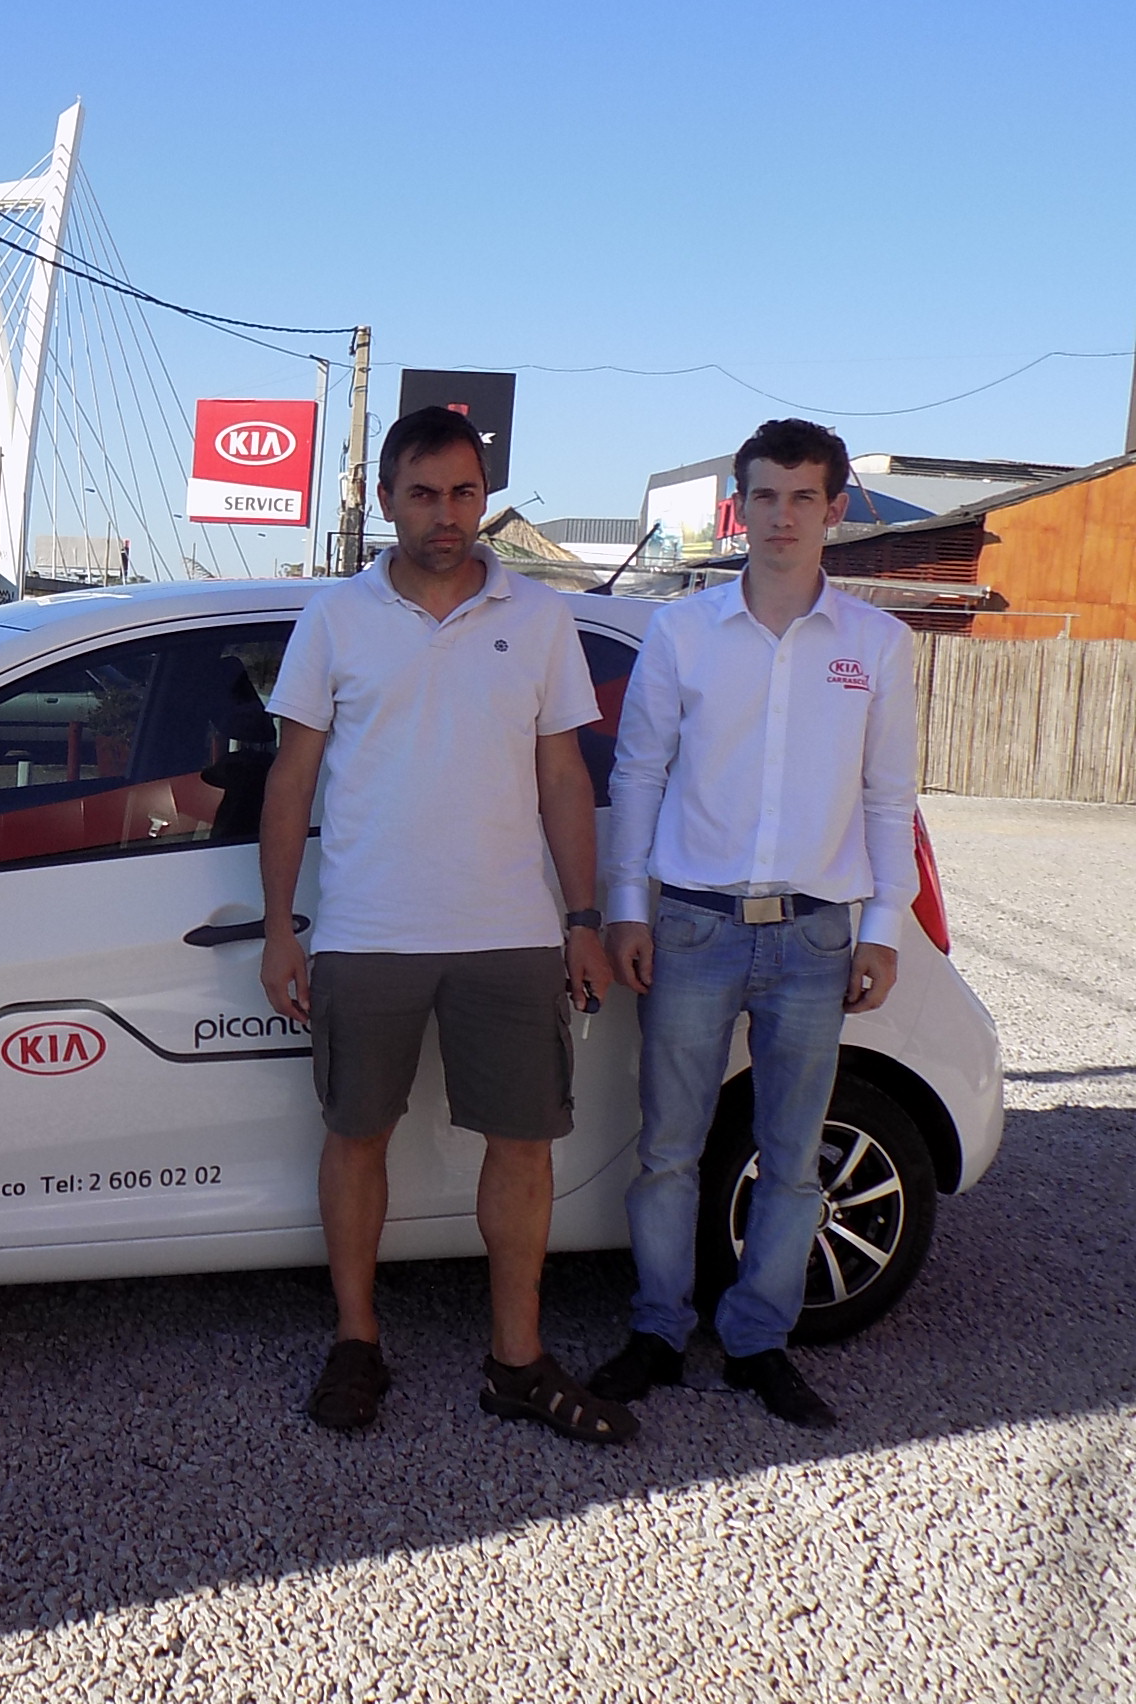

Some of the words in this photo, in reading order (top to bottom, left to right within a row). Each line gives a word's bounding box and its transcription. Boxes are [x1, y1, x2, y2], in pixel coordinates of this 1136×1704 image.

[228, 430, 283, 456] KIA
[224, 496, 295, 512] SERVICE
[19, 1033, 89, 1065] KIA
[40, 1174, 83, 1194] Tel:
[88, 1173, 101, 1191] 2
[109, 1171, 153, 1190] 606
[159, 1168, 187, 1186] 02
[195, 1165, 222, 1184] 02
